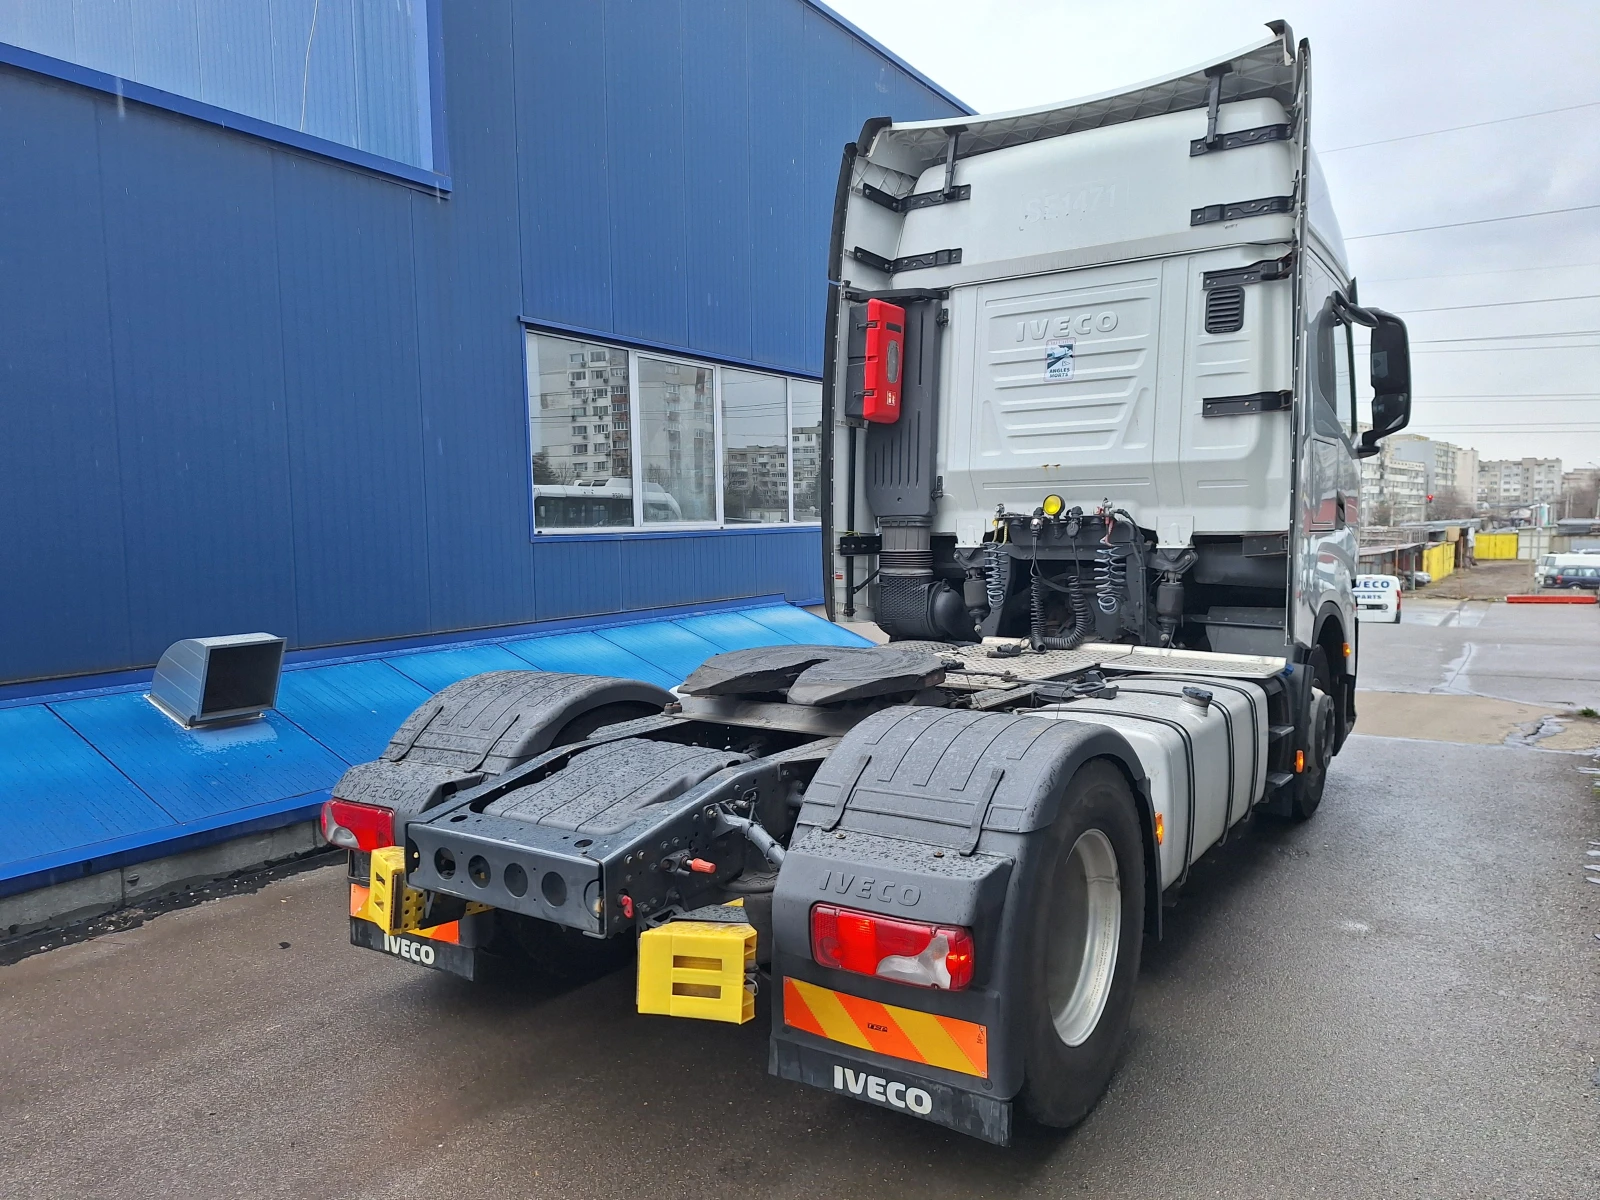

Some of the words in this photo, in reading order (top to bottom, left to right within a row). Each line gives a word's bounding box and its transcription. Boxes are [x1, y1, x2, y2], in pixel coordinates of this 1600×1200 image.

[1016, 311, 1118, 342] IVECO
[819, 869, 921, 907] IVECO
[383, 933, 435, 965] IVECO
[833, 1065, 933, 1115] IVECO
